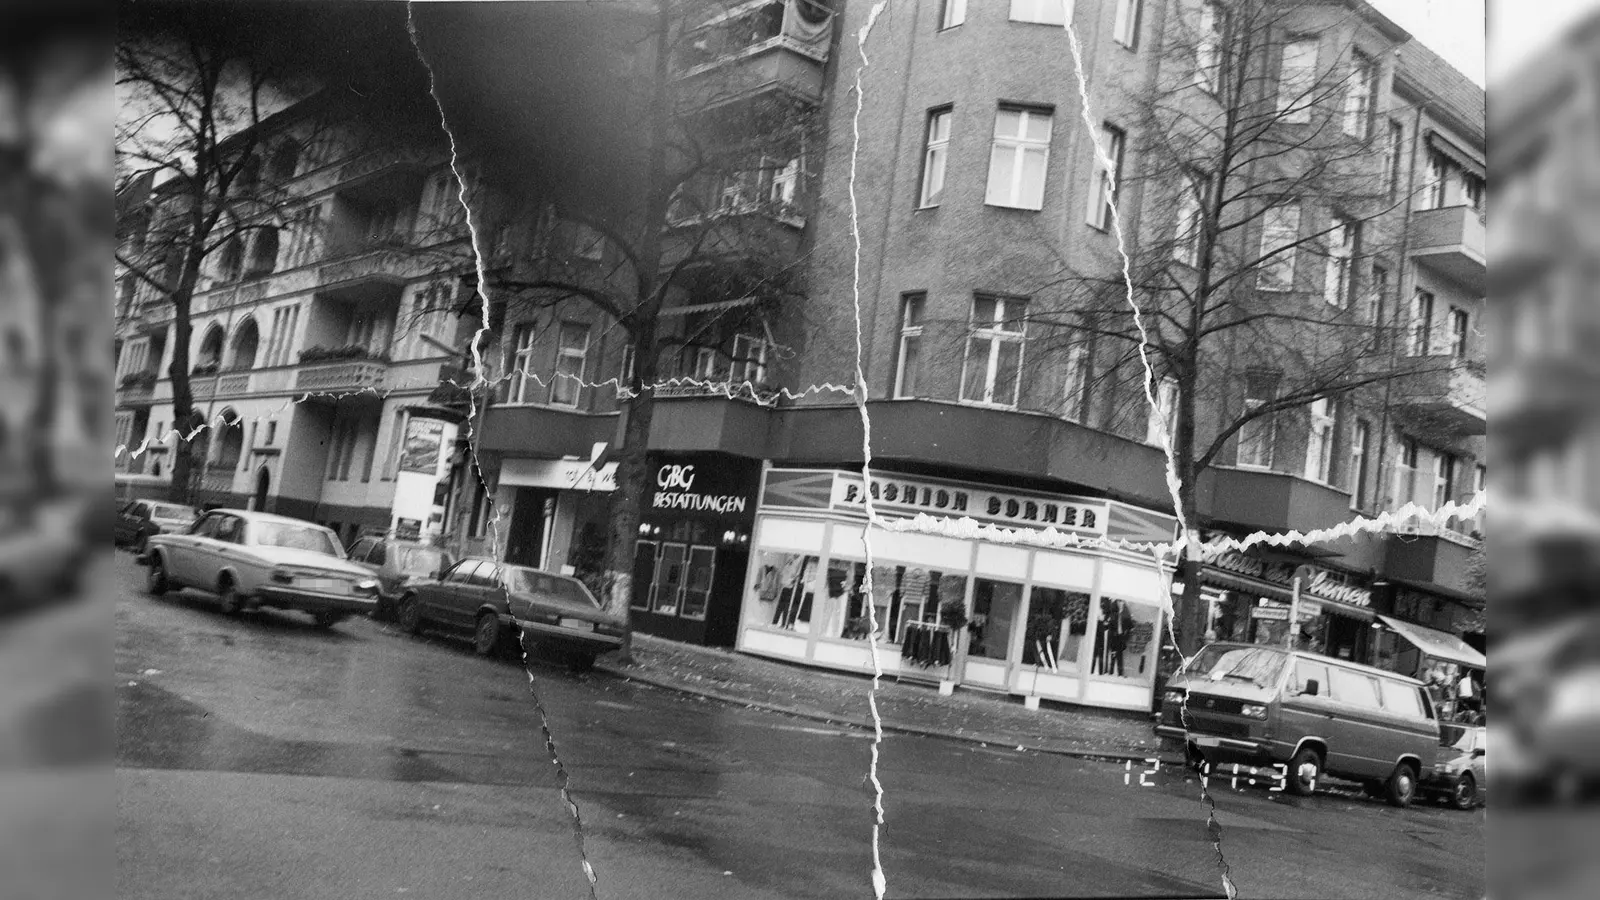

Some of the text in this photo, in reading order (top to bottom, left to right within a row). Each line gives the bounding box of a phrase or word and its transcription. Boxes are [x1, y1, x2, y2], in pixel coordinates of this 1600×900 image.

[657, 464, 695, 492] GBG
[652, 491, 747, 515] BESTATTUNGEN
[844, 480, 1096, 529] FASHION CORNER
